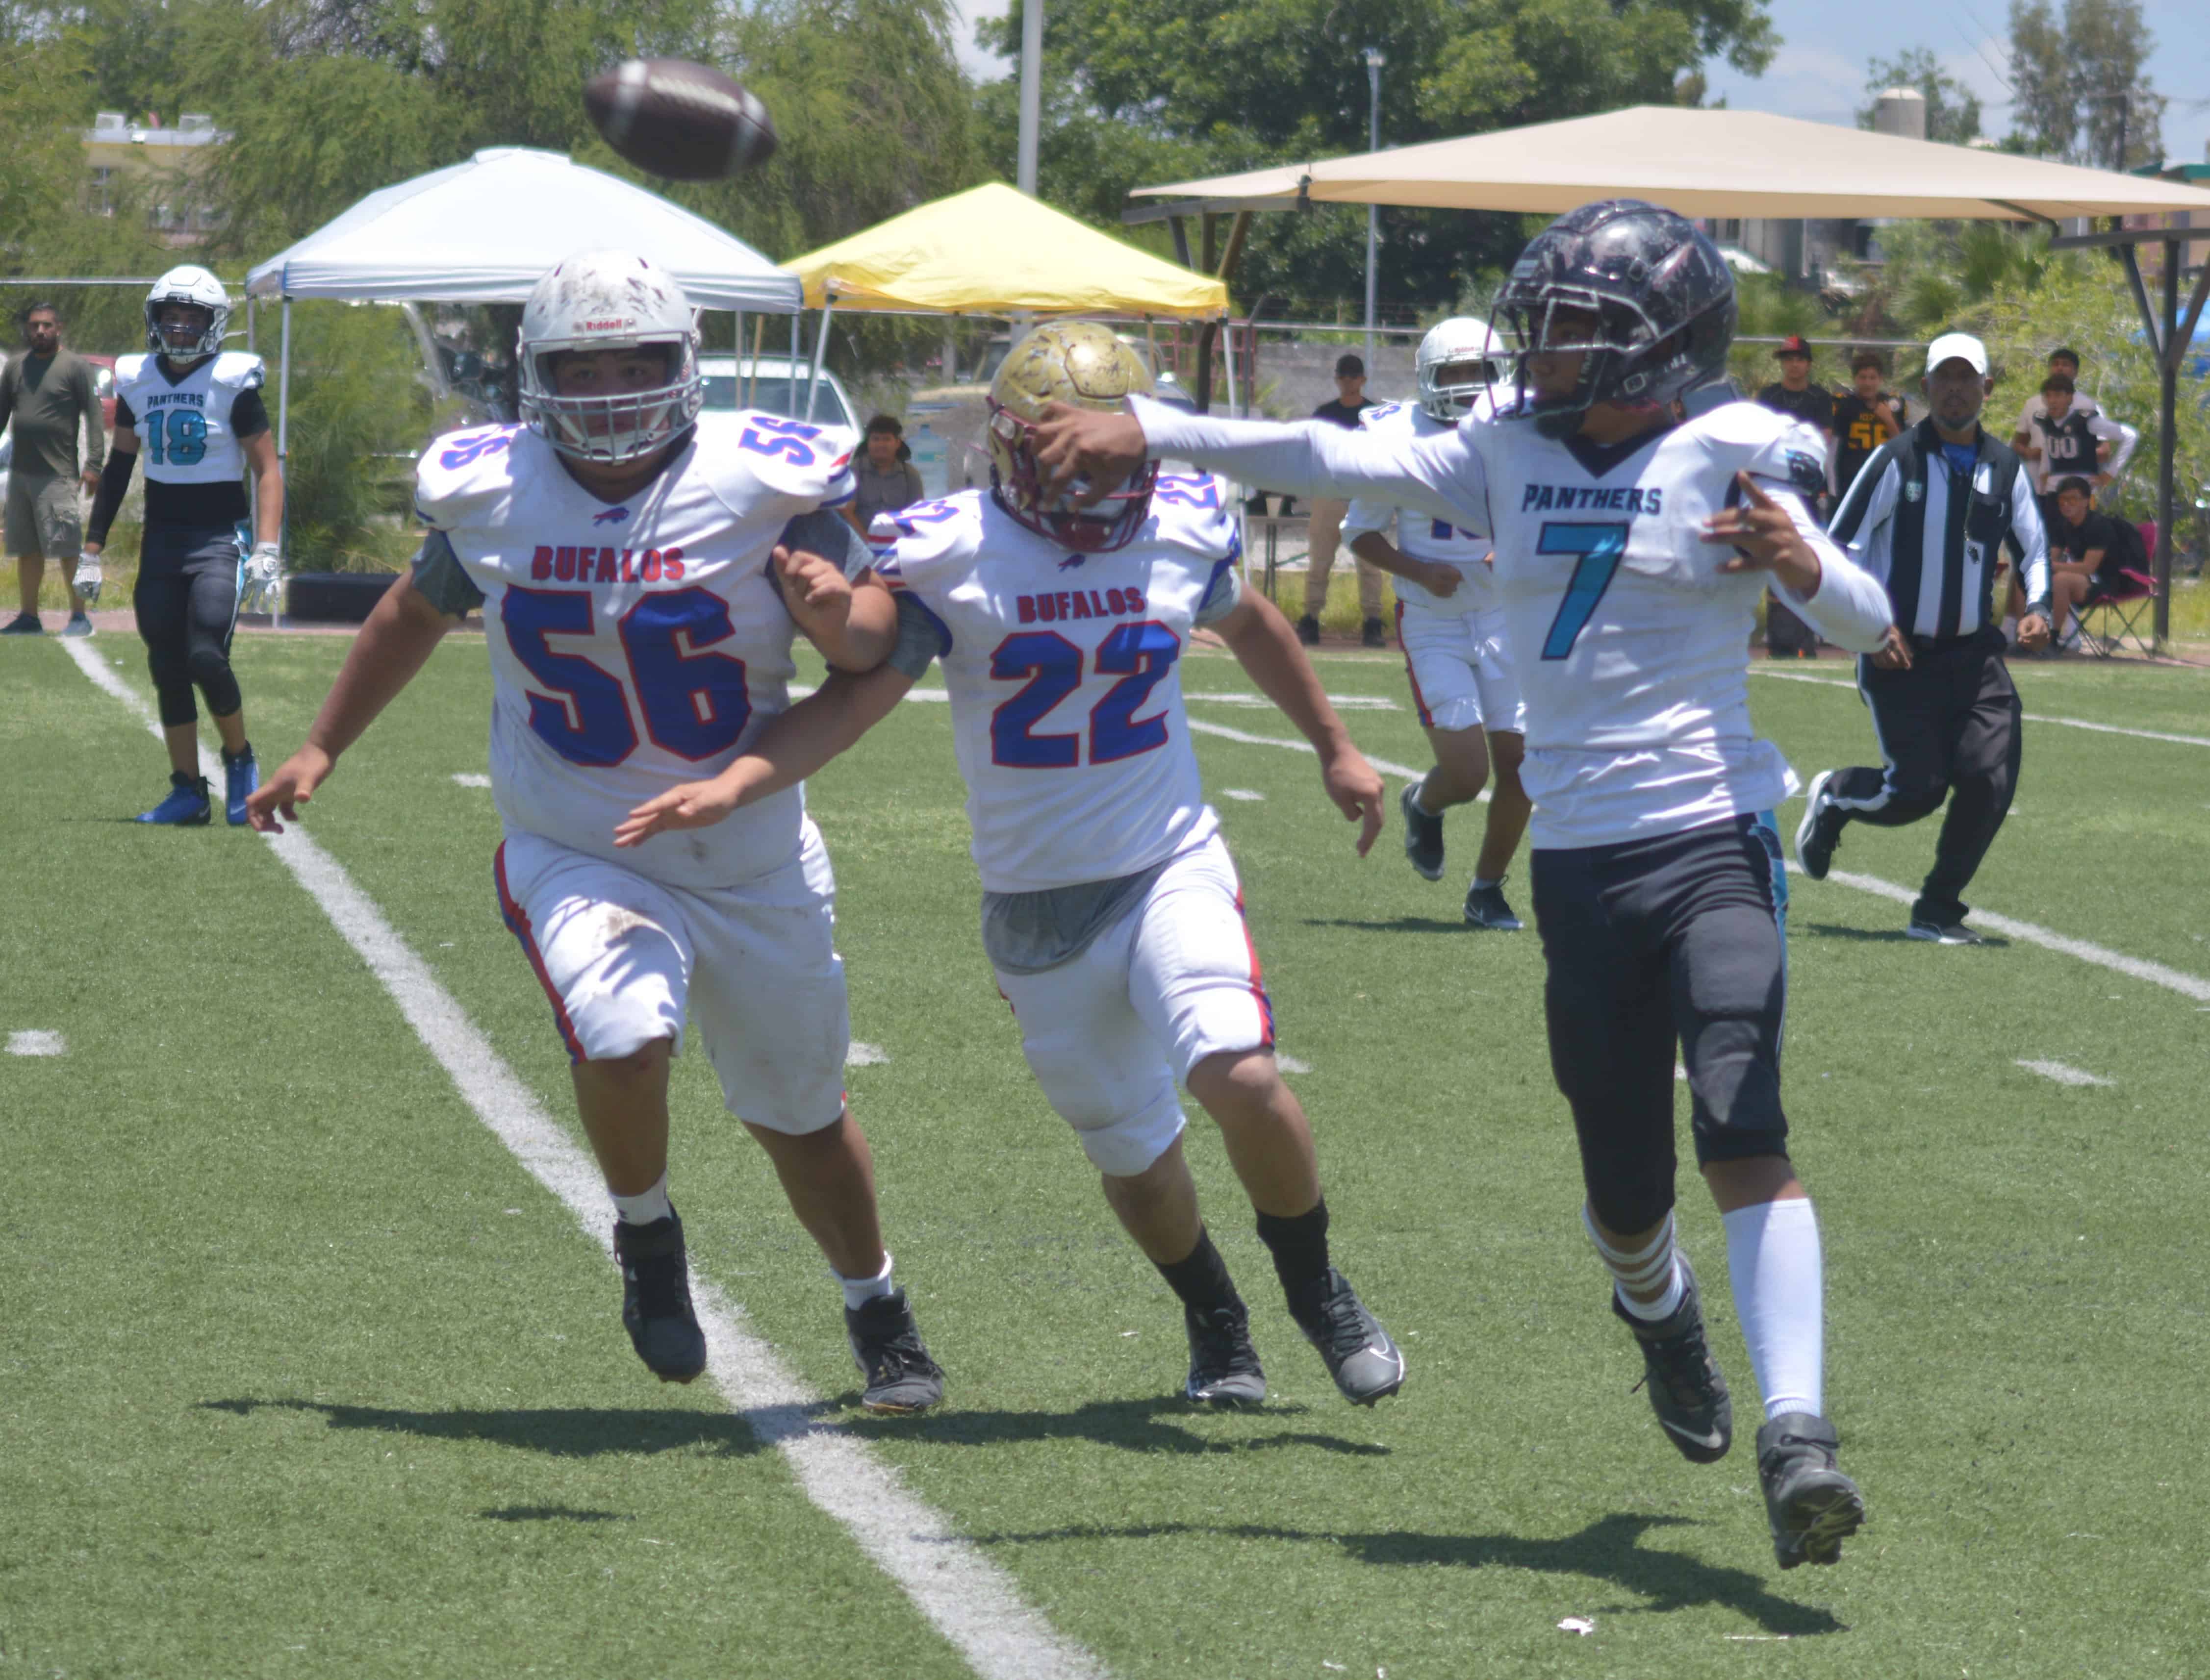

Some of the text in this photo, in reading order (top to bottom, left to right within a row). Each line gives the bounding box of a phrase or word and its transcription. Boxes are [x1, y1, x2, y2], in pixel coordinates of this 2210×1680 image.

[148, 393, 204, 409] PANTHERS
[144, 409, 207, 465] 18
[1522, 483, 1663, 515] PANTHERS
[532, 546, 685, 583] BUFALOS
[1016, 587, 1145, 624] BUFALOS
[1535, 521, 1630, 661] 7
[501, 583, 752, 767] 56
[990, 620, 1181, 768] 22
